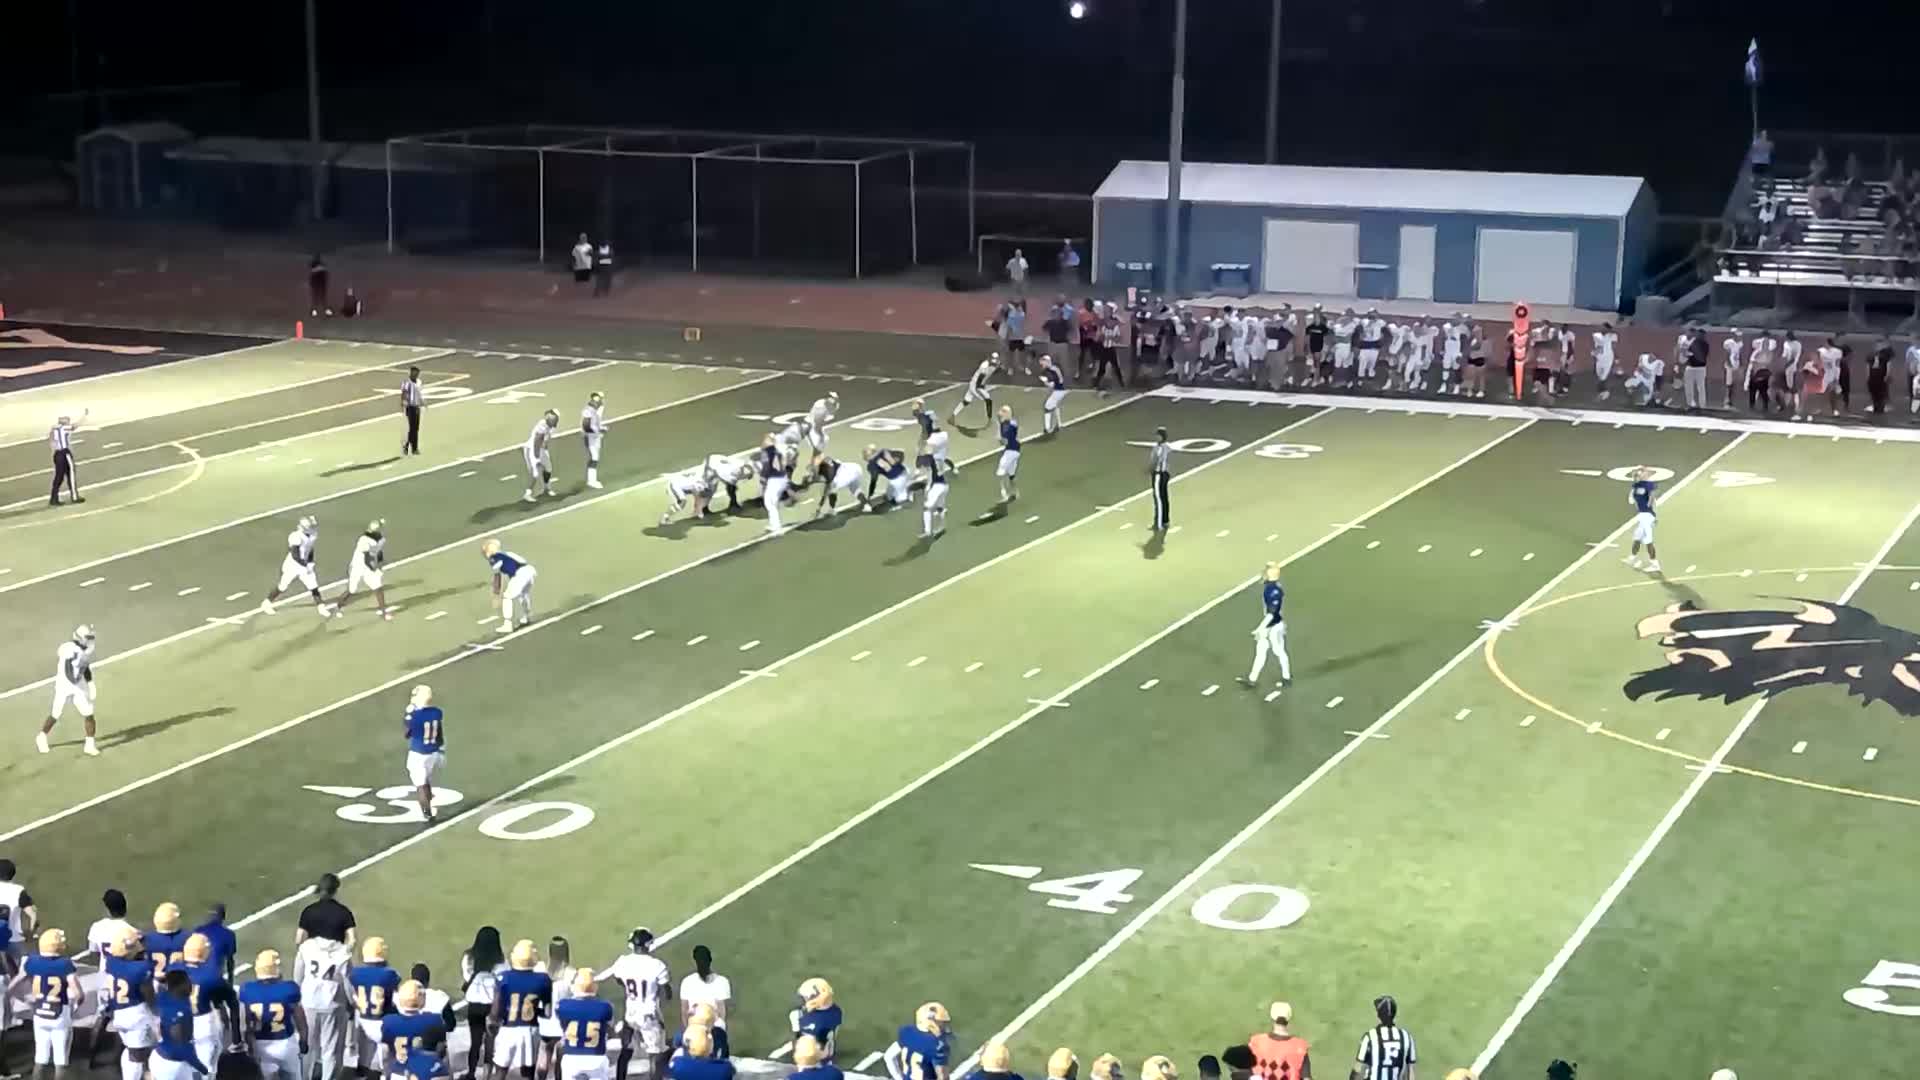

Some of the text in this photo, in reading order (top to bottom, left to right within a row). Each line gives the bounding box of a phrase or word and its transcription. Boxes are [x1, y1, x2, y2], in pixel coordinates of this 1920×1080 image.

[1028, 868, 1310, 931] 40
[565, 1021, 601, 1048] 45
[1382, 1041, 1401, 1066] F
